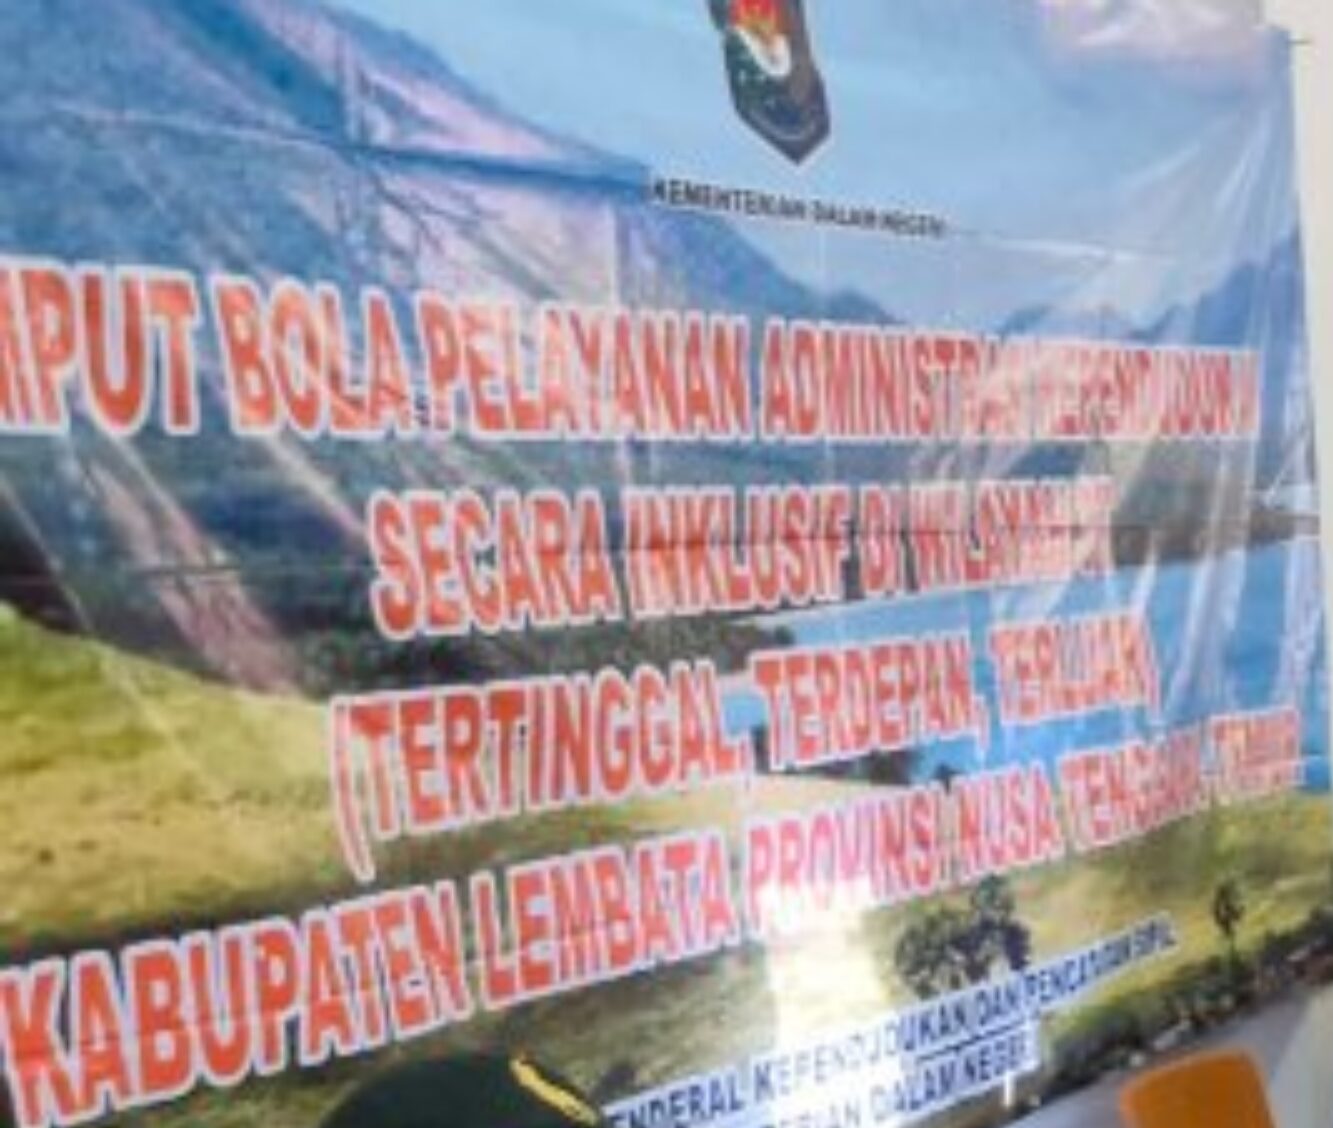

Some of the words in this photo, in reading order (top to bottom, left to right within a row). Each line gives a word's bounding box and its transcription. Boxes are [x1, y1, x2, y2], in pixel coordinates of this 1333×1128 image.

[207, 272, 411, 436] BOLA
[416, 290, 751, 440] PELAYANAN
[370, 488, 622, 637] SECARA
[622, 482, 852, 618] INKLUSIF
[858, 481, 904, 600] DI
[474, 832, 738, 1010] LEMBATA
[744, 786, 948, 938] PROVINSI
[953, 757, 1064, 882] NUSA
